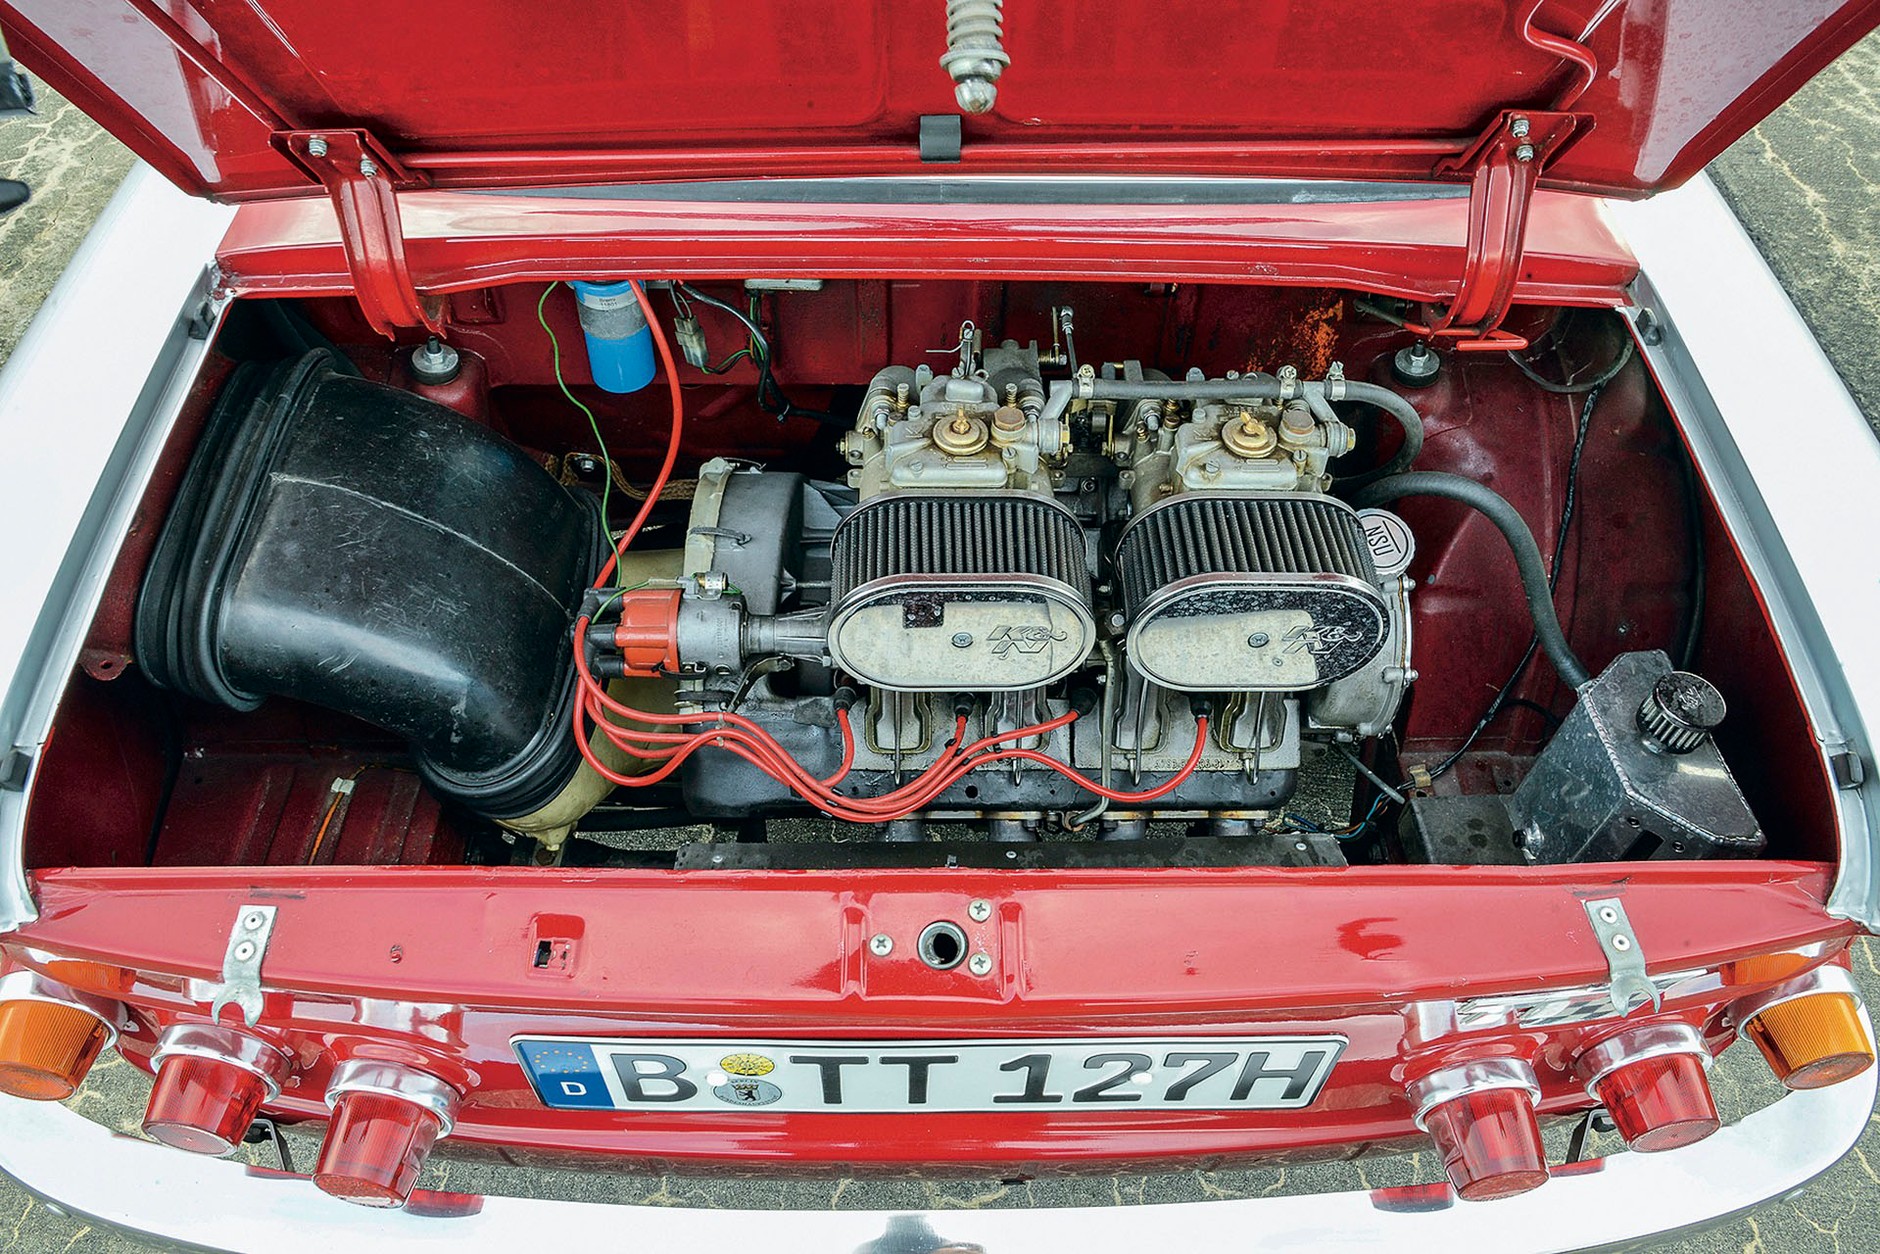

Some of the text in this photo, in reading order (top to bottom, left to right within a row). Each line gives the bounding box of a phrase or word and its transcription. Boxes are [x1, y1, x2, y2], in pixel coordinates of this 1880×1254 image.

[1366, 526, 1395, 556] NSU
[560, 1081, 587, 1096] D
[610, 1051, 1326, 1104] B TT 127H
